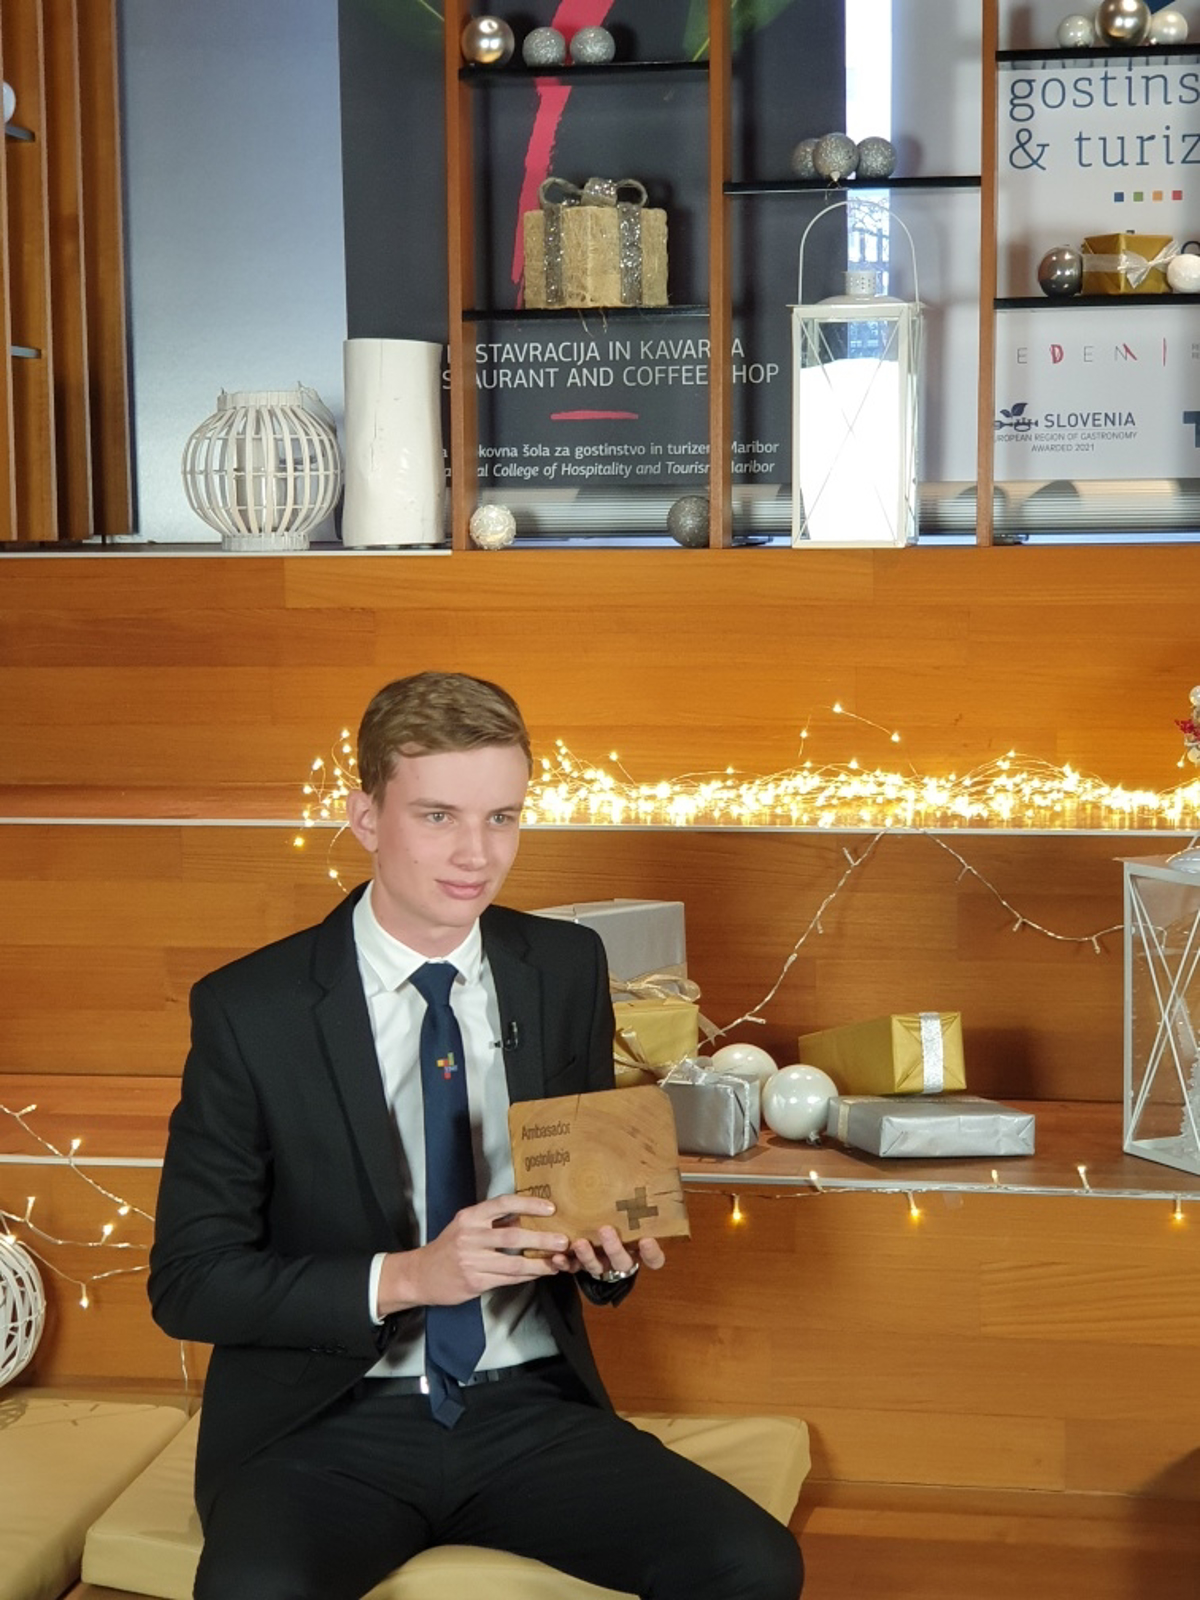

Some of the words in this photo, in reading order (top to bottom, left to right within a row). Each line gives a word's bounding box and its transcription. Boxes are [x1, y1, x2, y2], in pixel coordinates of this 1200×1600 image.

[1009, 128, 1050, 170] &
[446, 339, 601, 365] STAVRACIJA
[609, 340, 631, 361] IN
[640, 338, 745, 360] KAVARA
[442, 367, 560, 391] SURANT
[567, 366, 615, 388] AND
[623, 364, 709, 386] COFFEE
[733, 363, 780, 384] HOP
[1044, 412, 1137, 429] SLOVENIA
[1034, 433, 1066, 442] REGION
[1067, 432, 1079, 441] OF
[1080, 431, 1138, 441] GASTRONOMY
[478, 443, 519, 458] kovna
[523, 443, 551, 458] šola
[554, 446, 571, 457] za
[574, 442, 646, 460] gostinstvo
[650, 442, 663, 456] in
[1031, 443, 1074, 453] AWARDED
[1075, 443, 1096, 452] 2021
[493, 463, 540, 480] College
[543, 462, 558, 480] of
[561, 461, 633, 479] Hospitality
[635, 461, 662, 475] and
[731, 459, 776, 474] aribor
